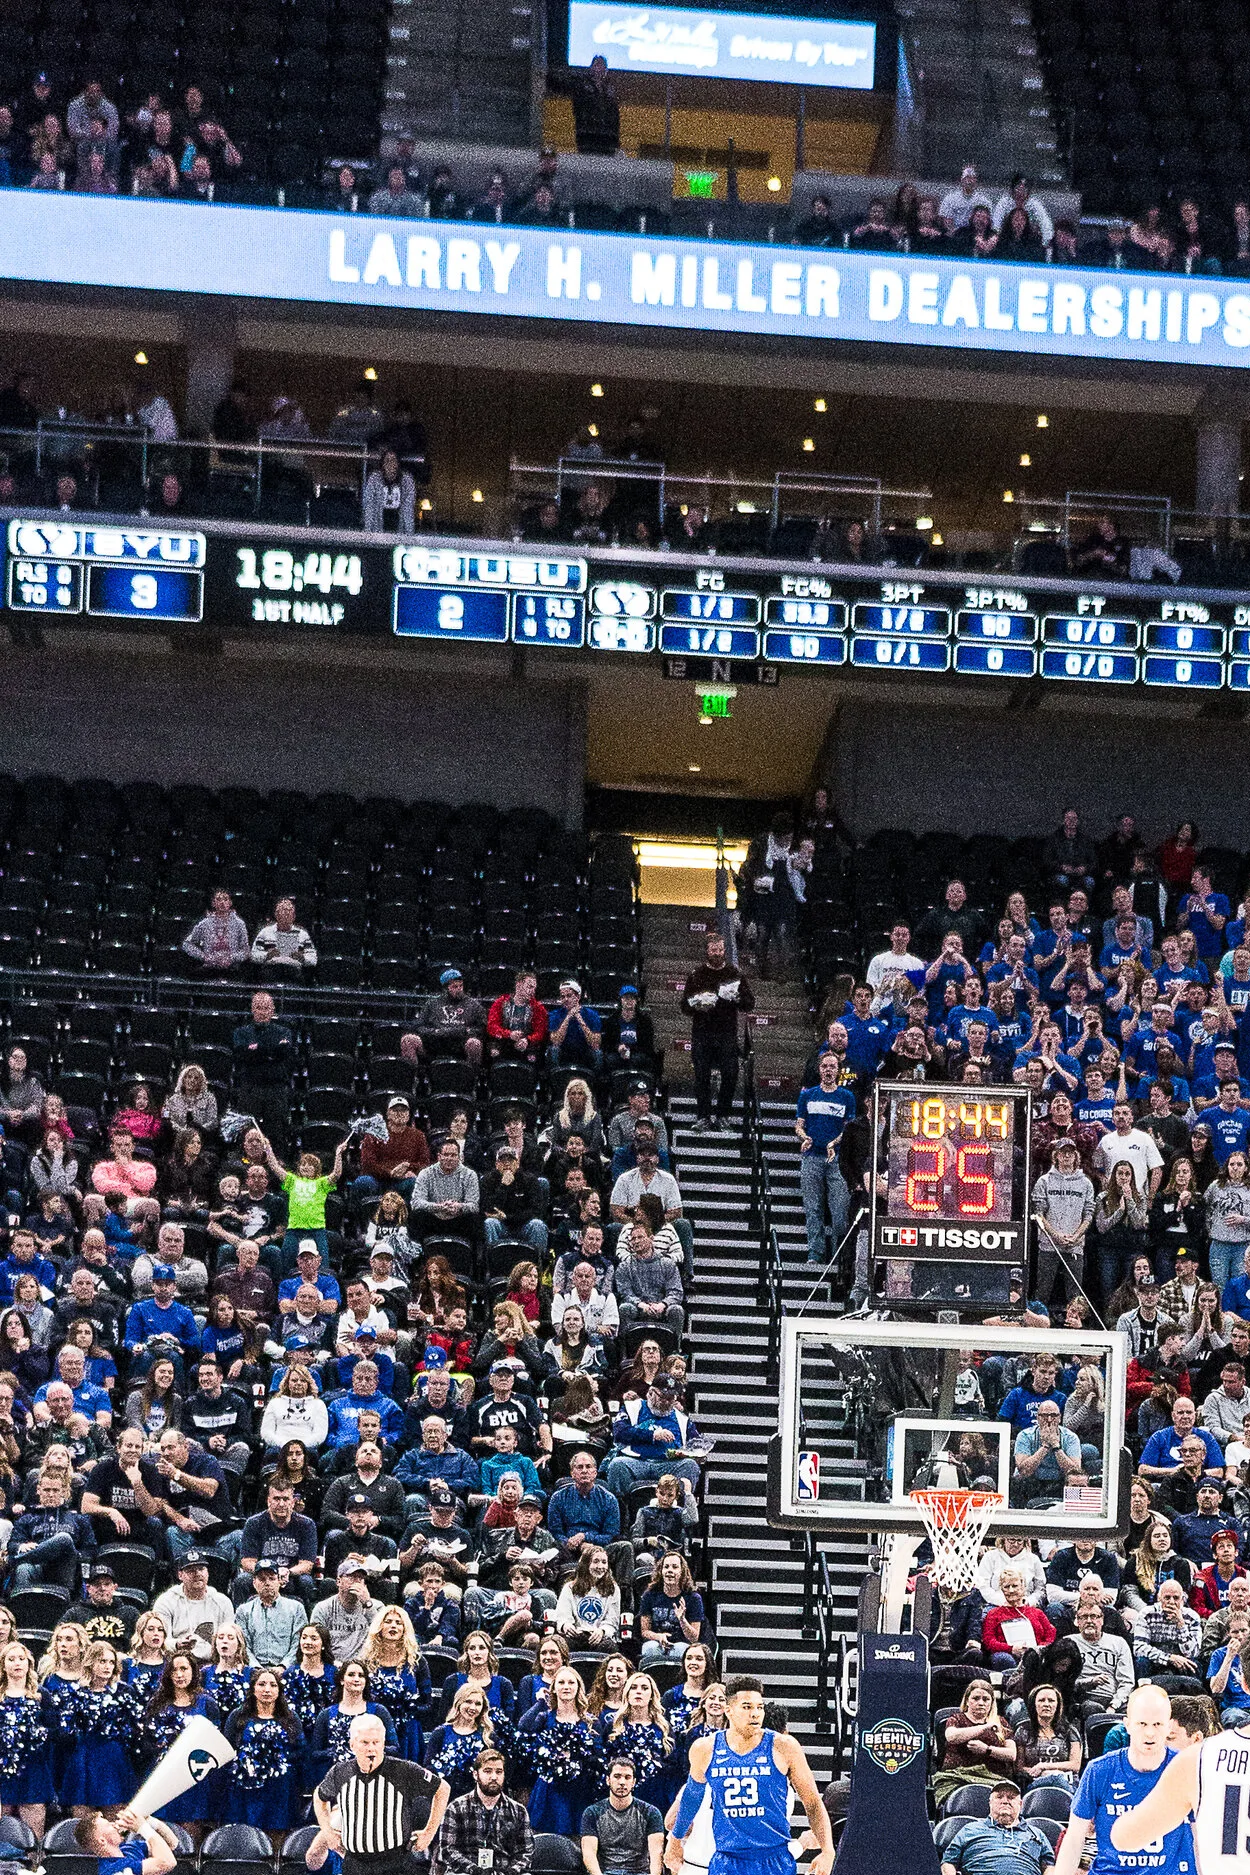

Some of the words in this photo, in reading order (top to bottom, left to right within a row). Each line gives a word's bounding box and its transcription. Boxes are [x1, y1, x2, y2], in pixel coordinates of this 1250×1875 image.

[329, 229, 521, 294] LARRY
[547, 245, 602, 301] H.
[631, 251, 841, 318] MILLER
[236, 548, 363, 596] 18:44
[130, 573, 158, 609] 3
[696, 570, 726, 591] FG
[1077, 596, 1106, 616] FT
[438, 594, 465, 630] 2
[1067, 621, 1115, 644] 0/0
[1176, 628, 1193, 649] 0
[712, 661, 732, 682] N
[987, 650, 1004, 671] 0
[1065, 654, 1114, 678] 0/0
[1175, 660, 1192, 682] 0
[911, 1098, 1008, 1139] 18:44
[905, 1141, 995, 1215] 25
[919, 1228, 1018, 1250] TISSOT
[489, 1410, 519, 1427] BYU
[874, 1649, 915, 1662] SPALDING
[865, 1732, 921, 1747] BEEHIVE
[873, 1743, 912, 1753] CLASSIC
[711, 1766, 771, 1778] BRIGHAM
[723, 1777, 759, 1807] 23
[722, 1807, 765, 1818] YOUNG
